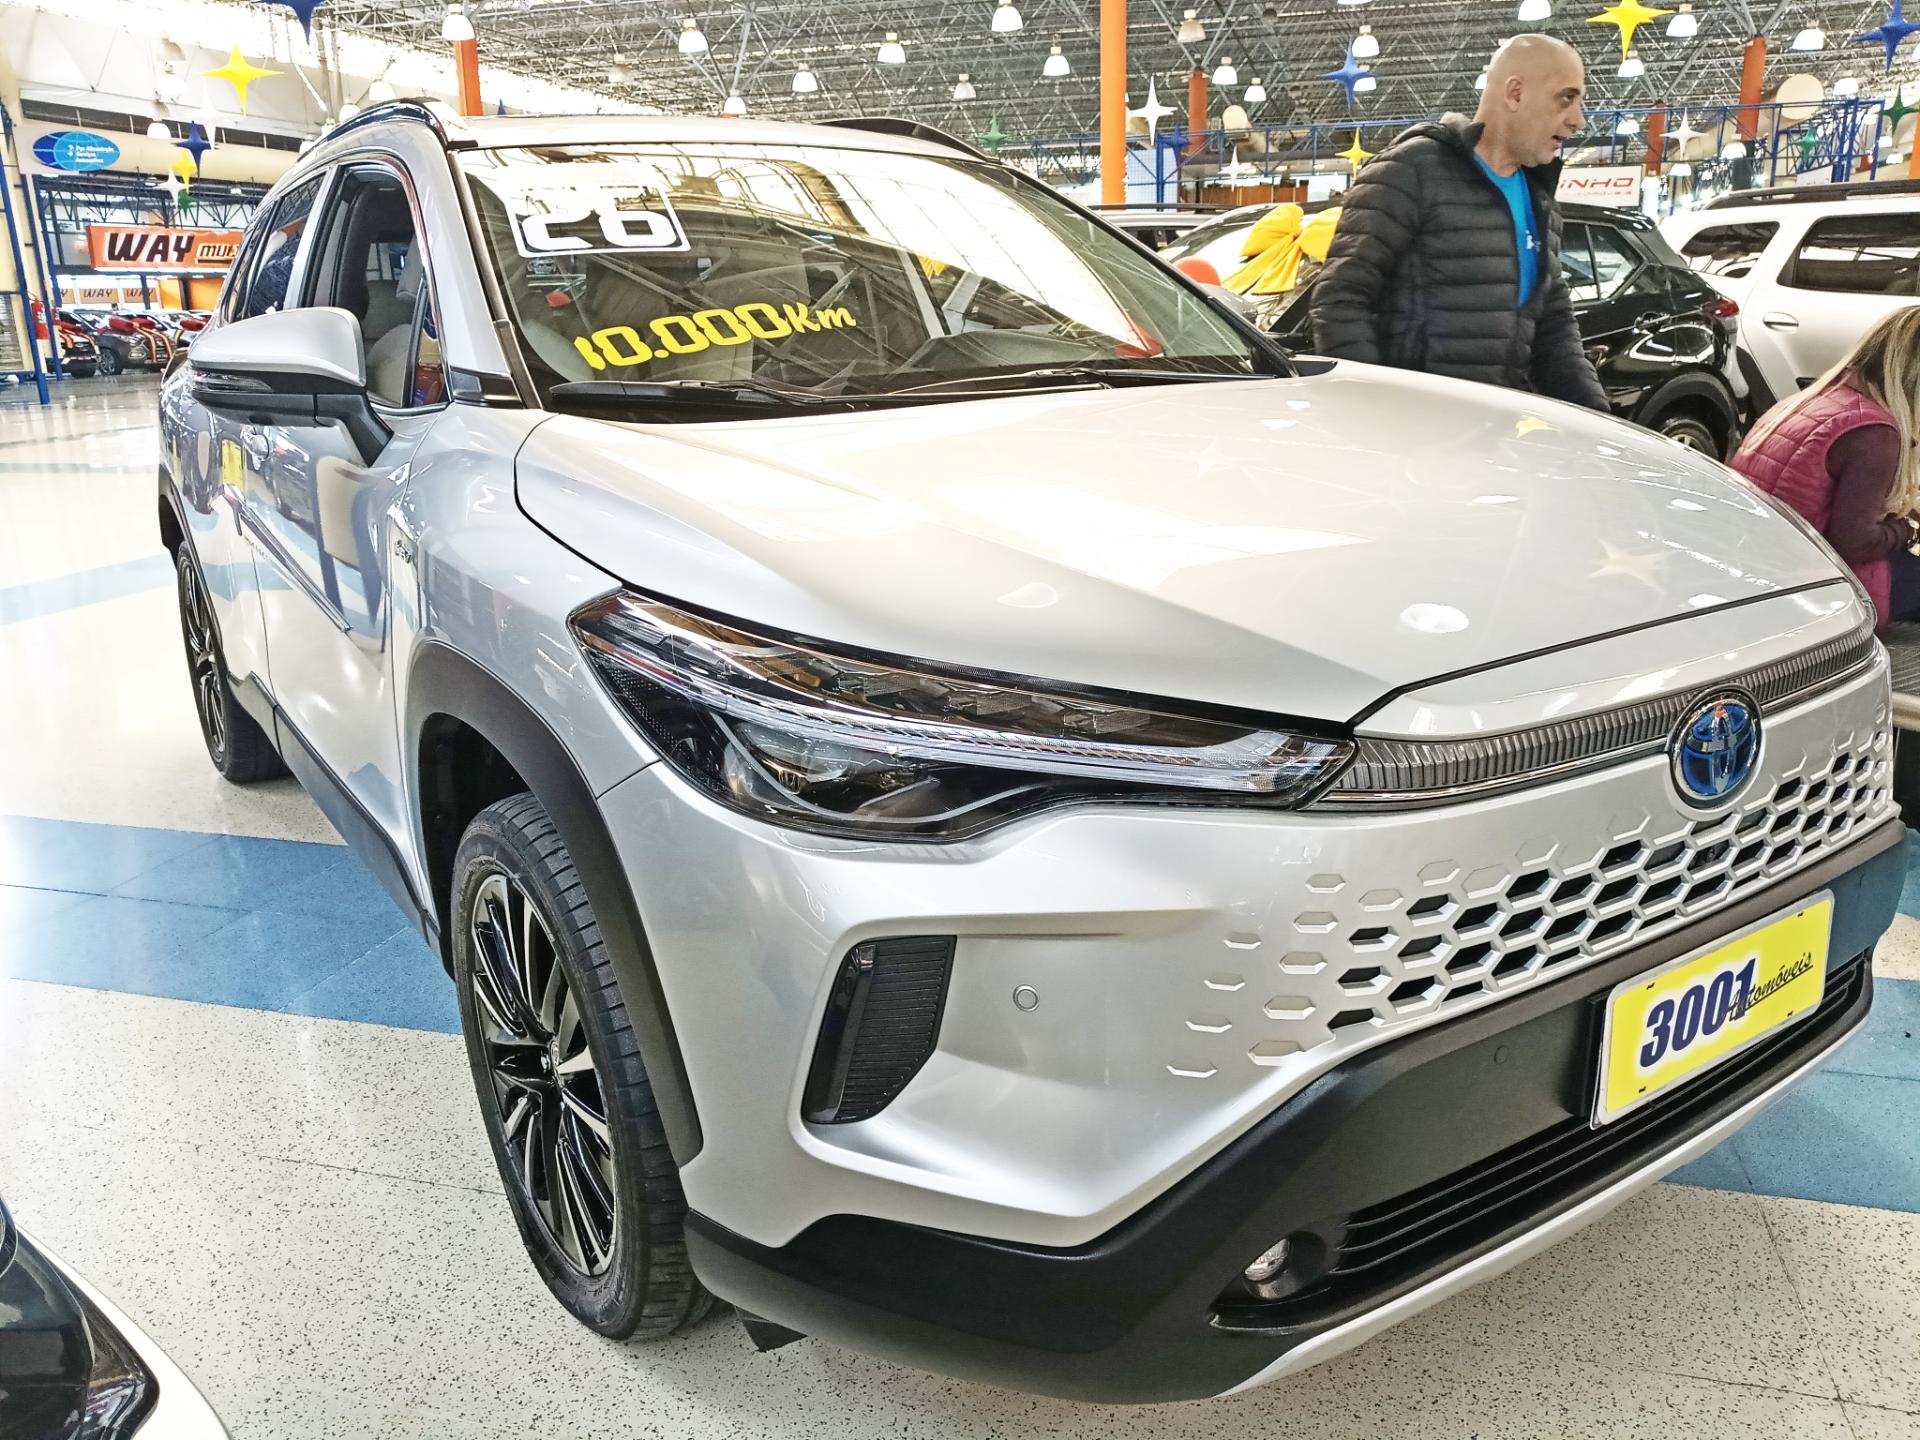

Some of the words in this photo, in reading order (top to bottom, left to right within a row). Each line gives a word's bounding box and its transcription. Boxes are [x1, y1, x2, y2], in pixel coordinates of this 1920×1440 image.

[107, 232, 195, 263] WAY
[199, 244, 239, 258] MUL
[83, 287, 113, 298] WAY
[1640, 958, 1756, 1068] 3001
[1722, 951, 1814, 1023] Automóveis
